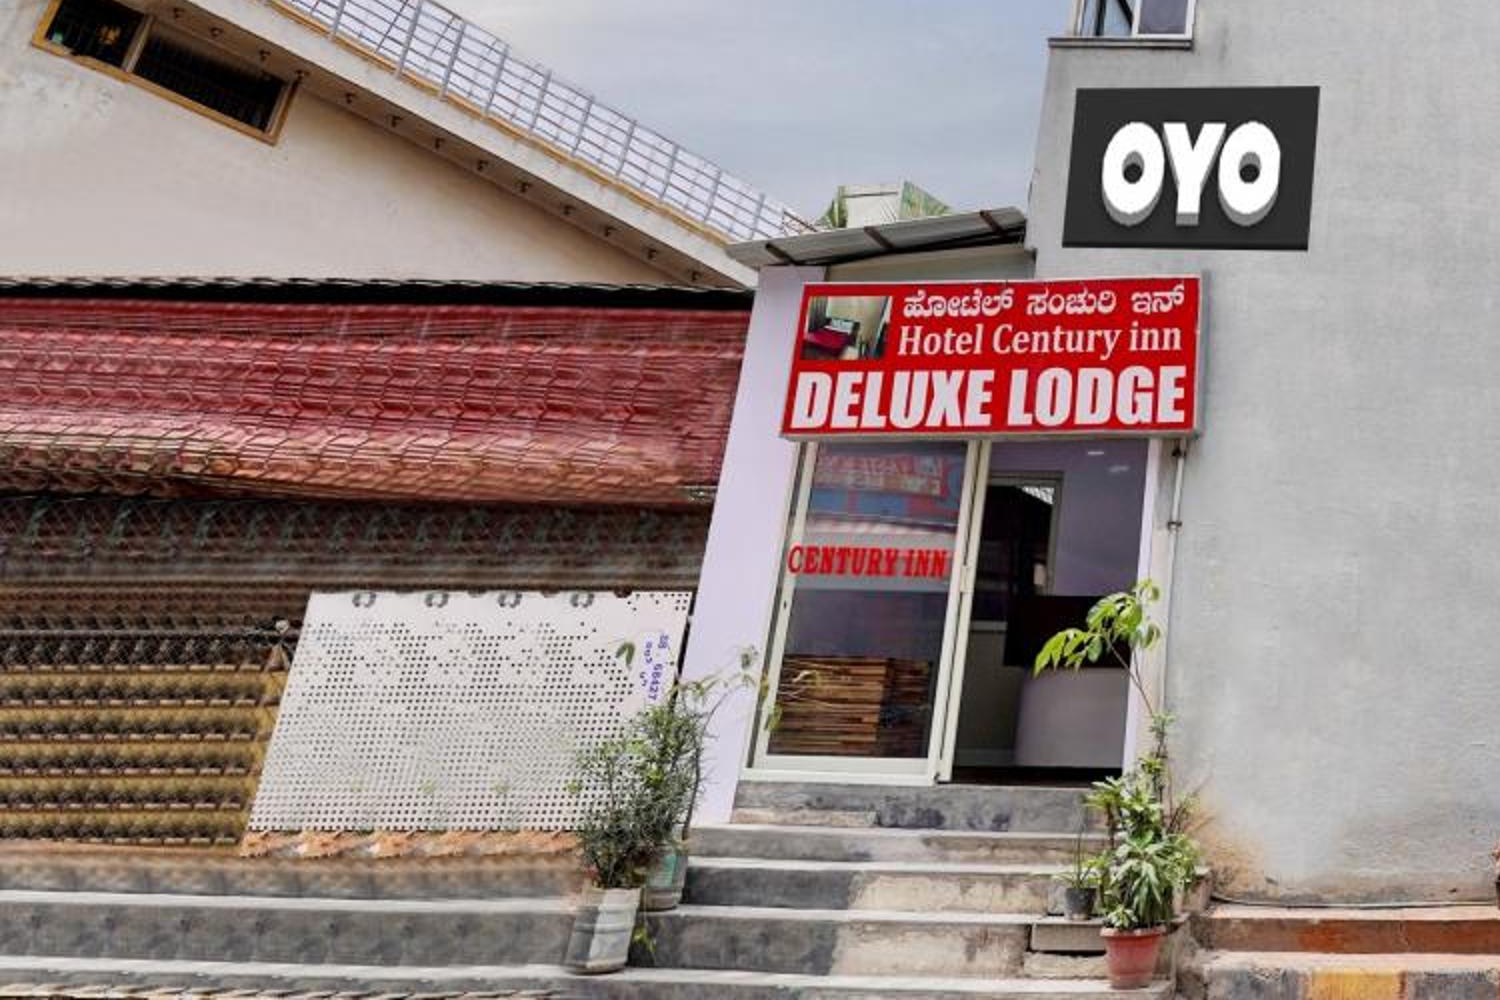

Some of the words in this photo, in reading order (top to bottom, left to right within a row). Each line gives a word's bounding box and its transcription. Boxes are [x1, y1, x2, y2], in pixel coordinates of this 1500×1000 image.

[1101, 120, 1281, 227] OYO
[903, 287, 1014, 318] ಹೋಟೆಲ್
[1131, 283, 1185, 315] ಇನ್
[897, 323, 982, 356] Hotel
[993, 322, 1121, 361] Century
[1129, 321, 1182, 352] inn
[790, 367, 996, 430] DELUXE
[1007, 365, 1187, 427] LODGE
[788, 545, 898, 577] CENTURY
[902, 548, 949, 580] INN
